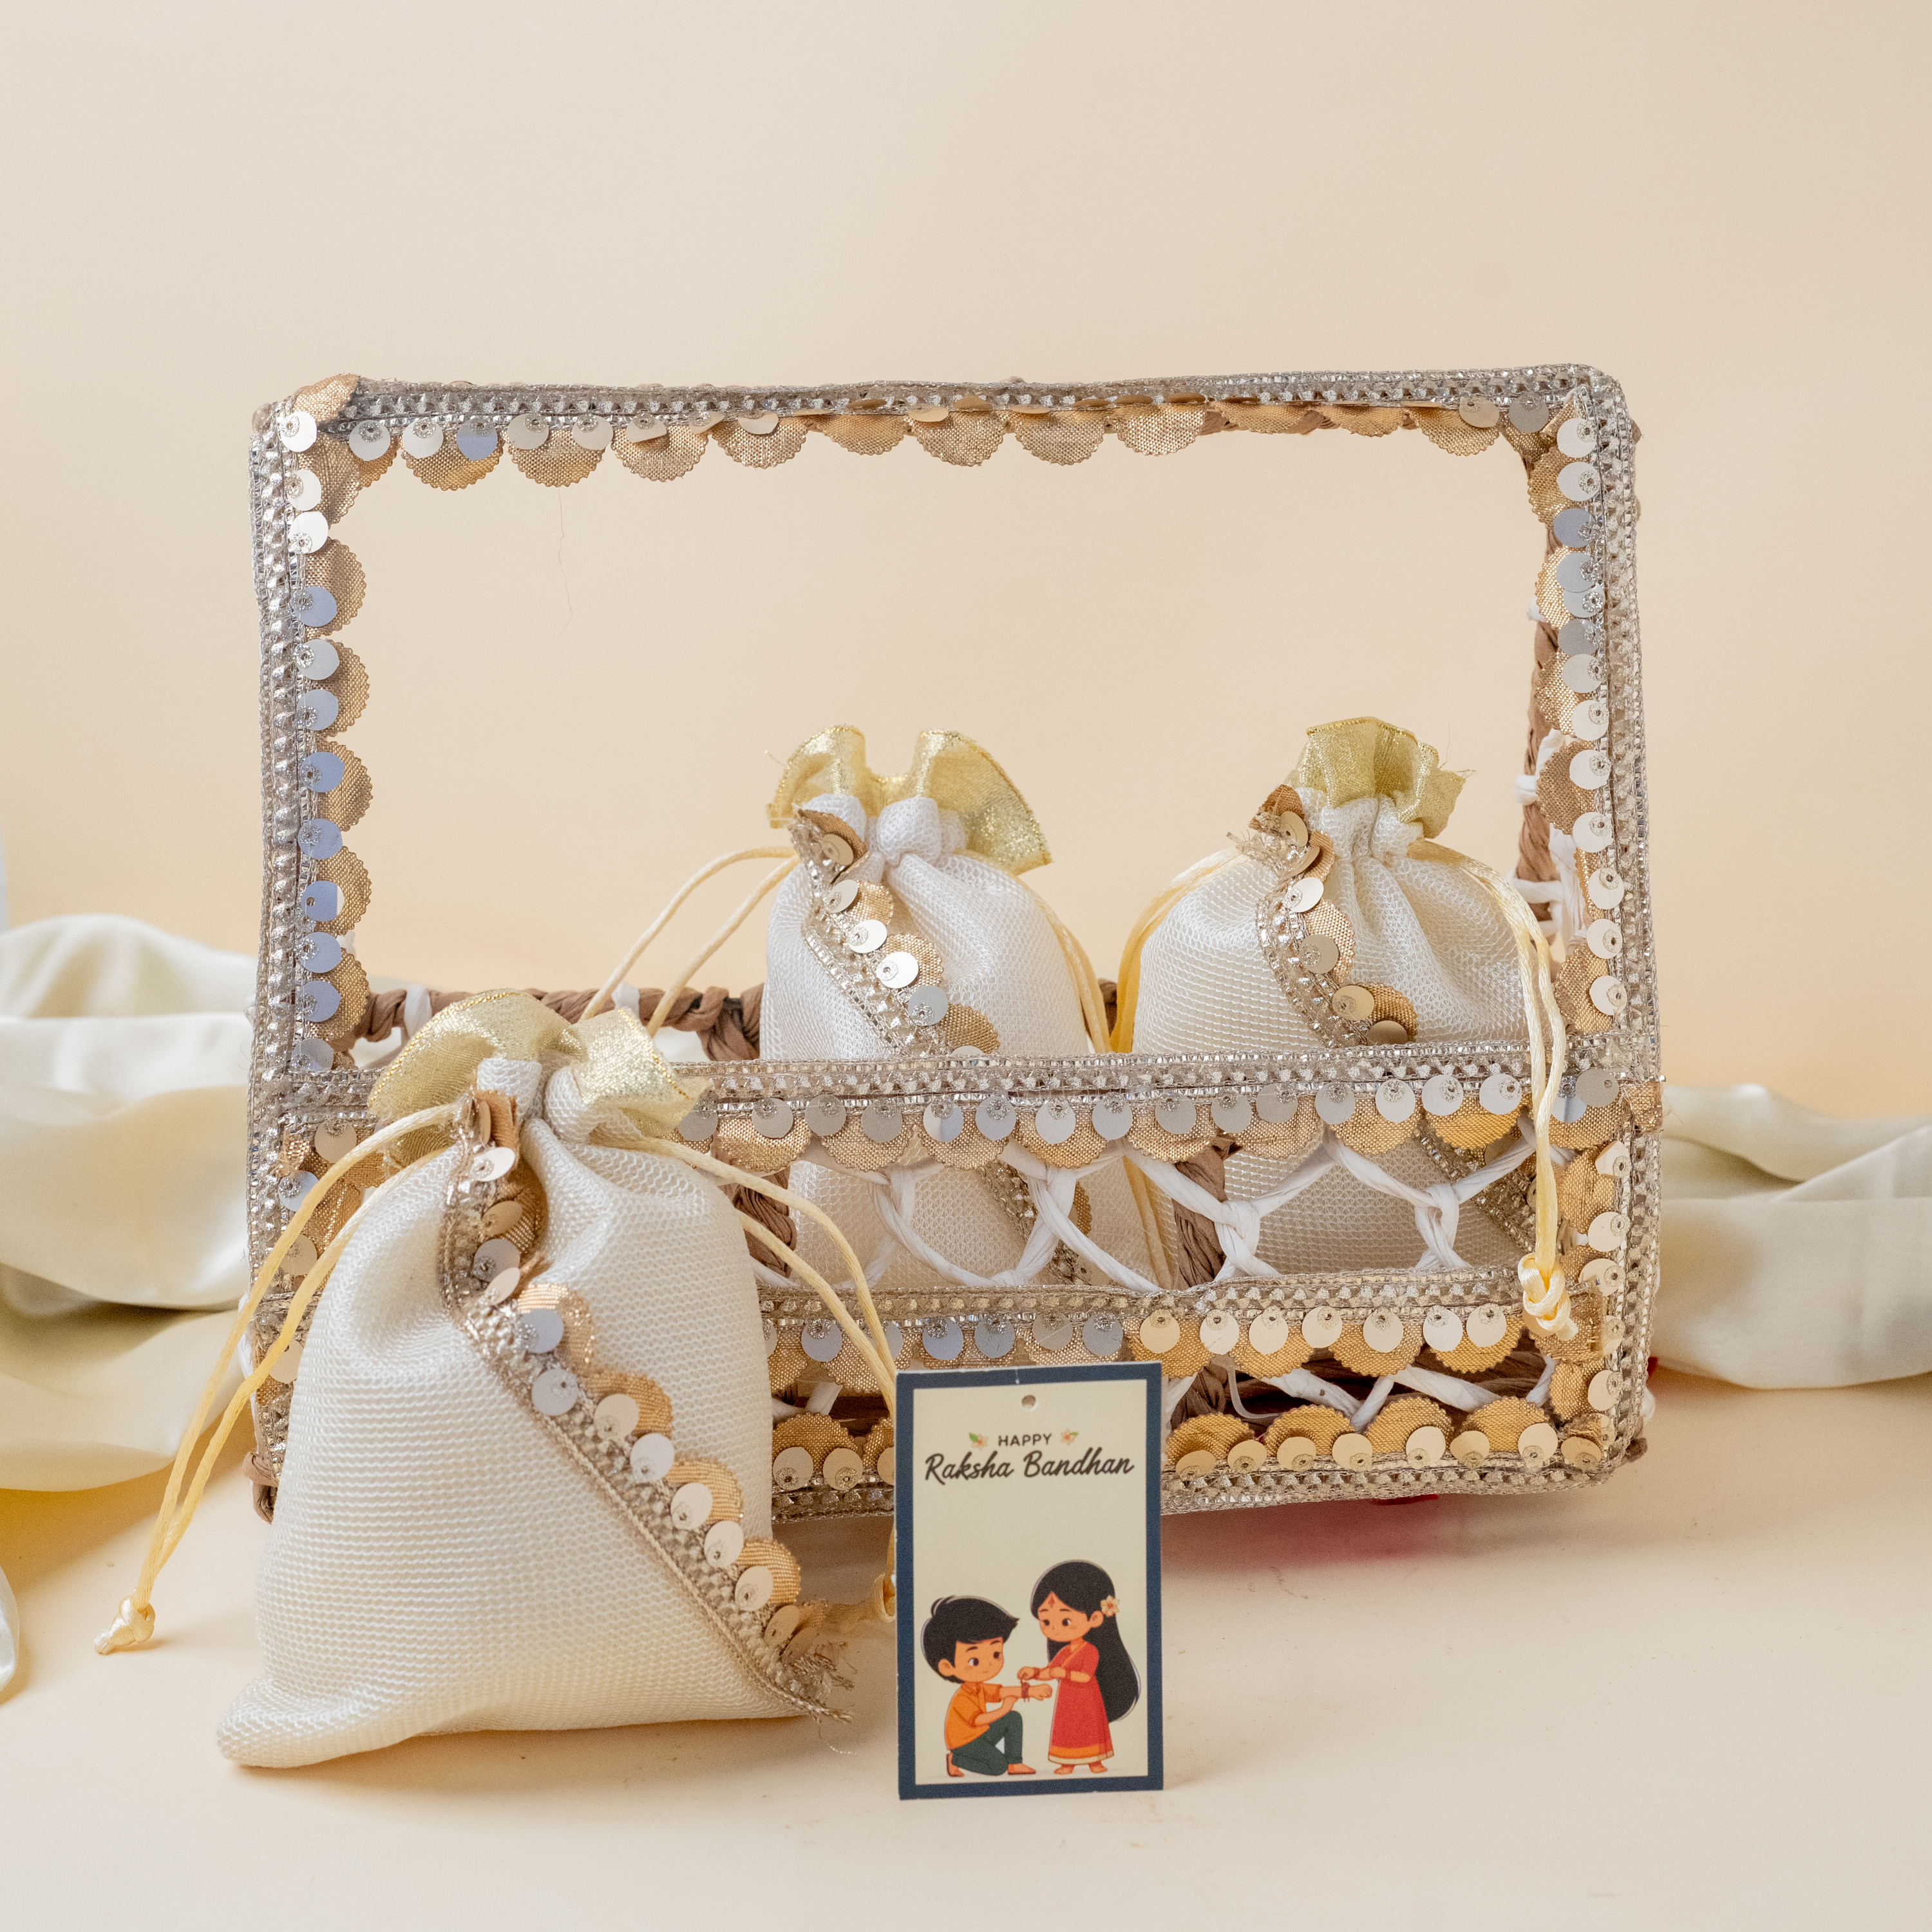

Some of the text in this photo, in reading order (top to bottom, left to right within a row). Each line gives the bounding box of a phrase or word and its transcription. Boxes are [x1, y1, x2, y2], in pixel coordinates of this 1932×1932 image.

[998, 1433, 1052, 1446] HAPPY
[925, 1446, 1135, 1486] Raksha Bandhan
